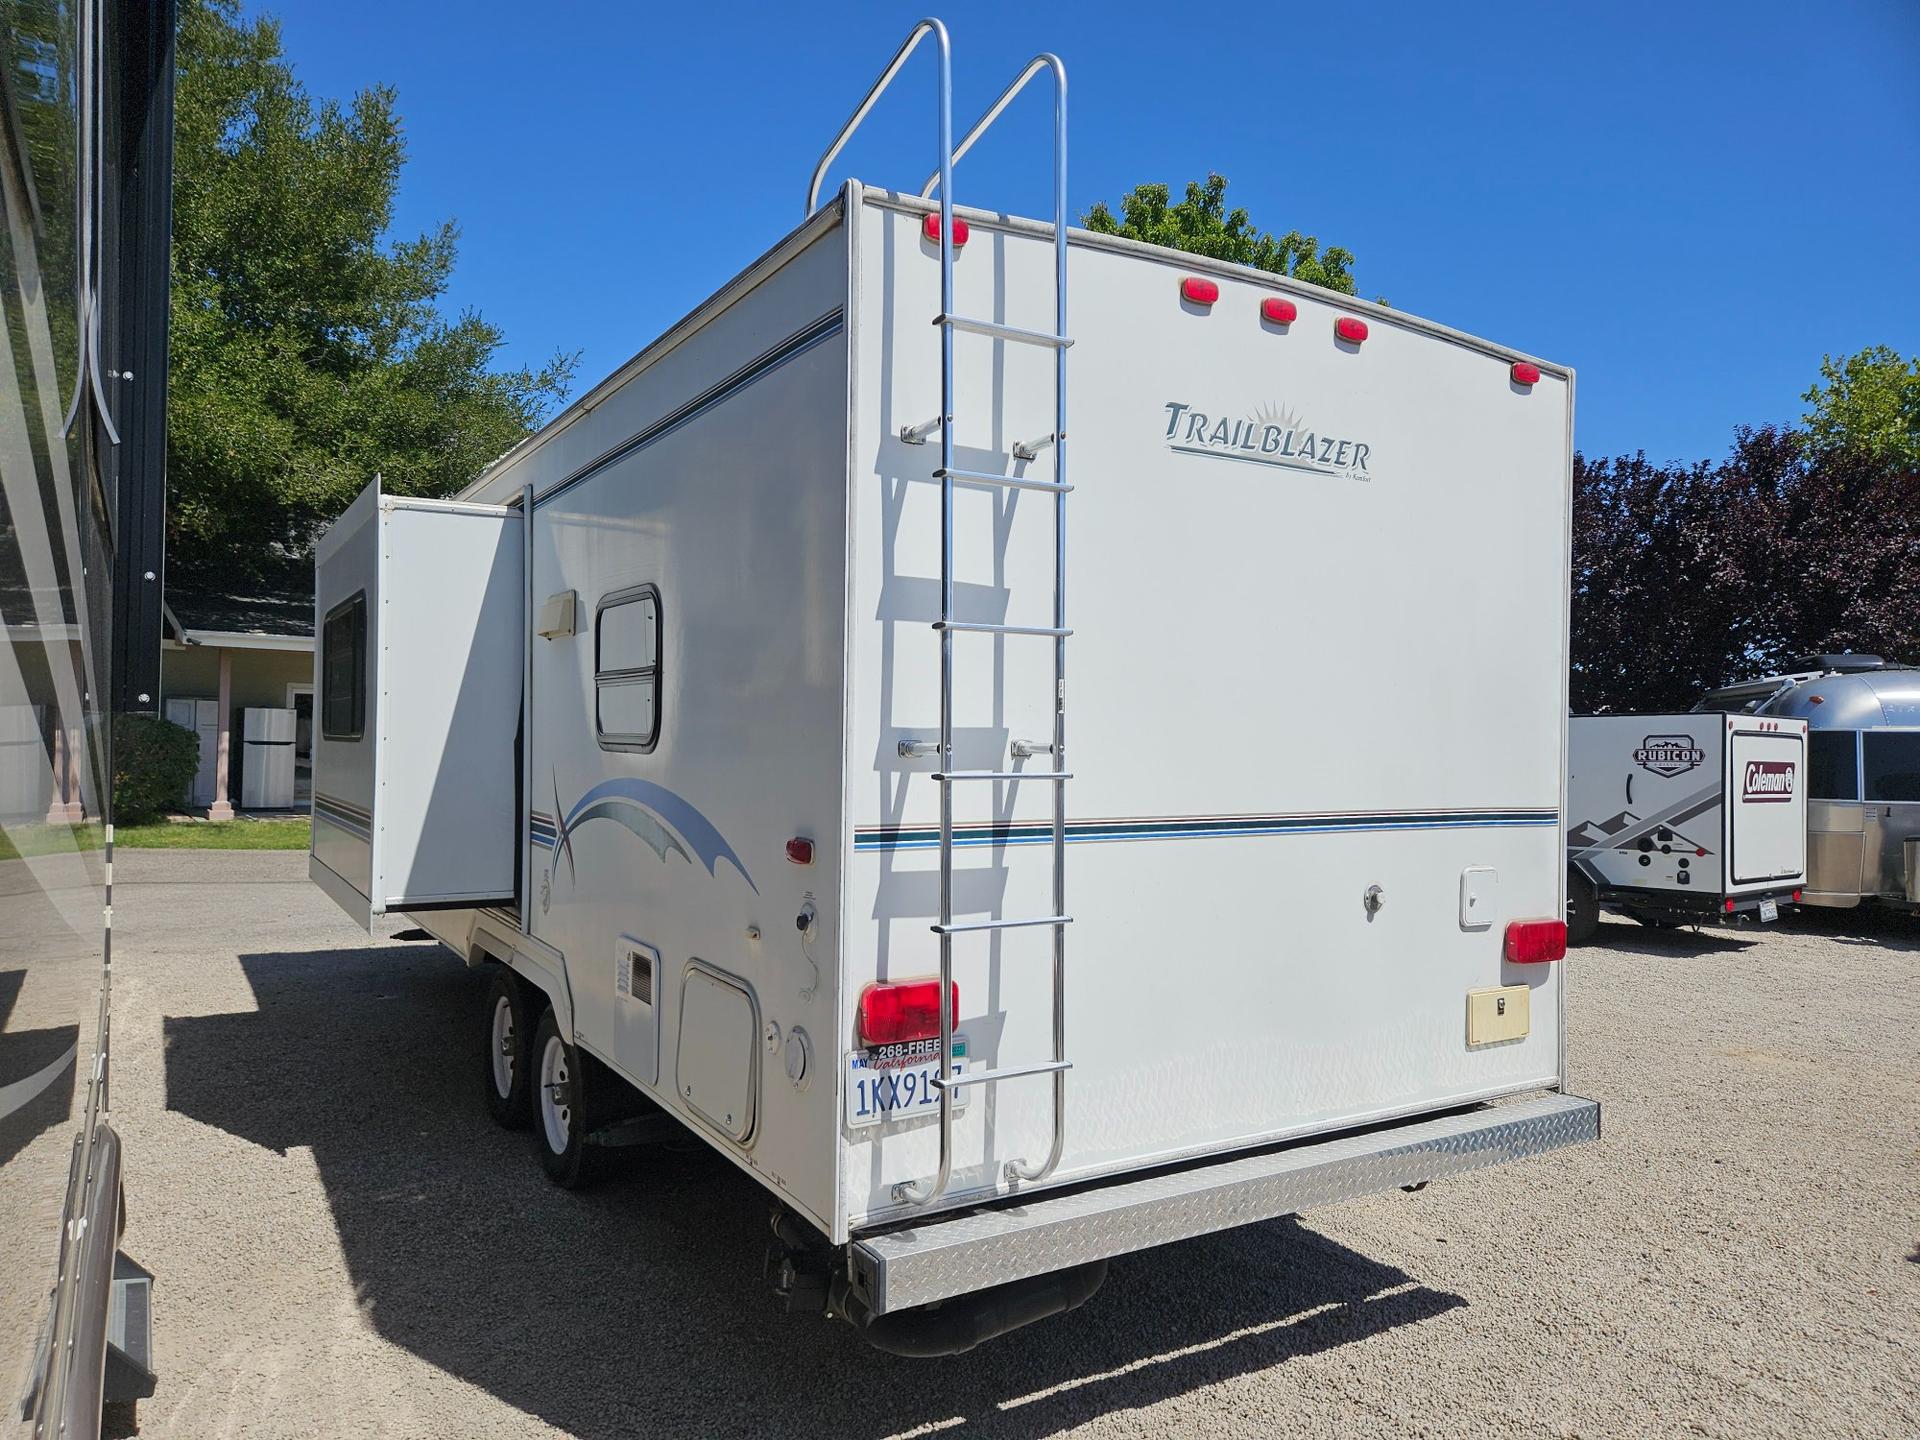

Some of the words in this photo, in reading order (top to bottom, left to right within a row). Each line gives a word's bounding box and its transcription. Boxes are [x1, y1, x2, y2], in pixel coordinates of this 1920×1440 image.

[1164, 401, 1371, 471] TRAILBLAZER
[1637, 750, 1700, 761] RUBICON
[1746, 763, 1785, 793] Coleman
[851, 1059, 868, 1070] MAY
